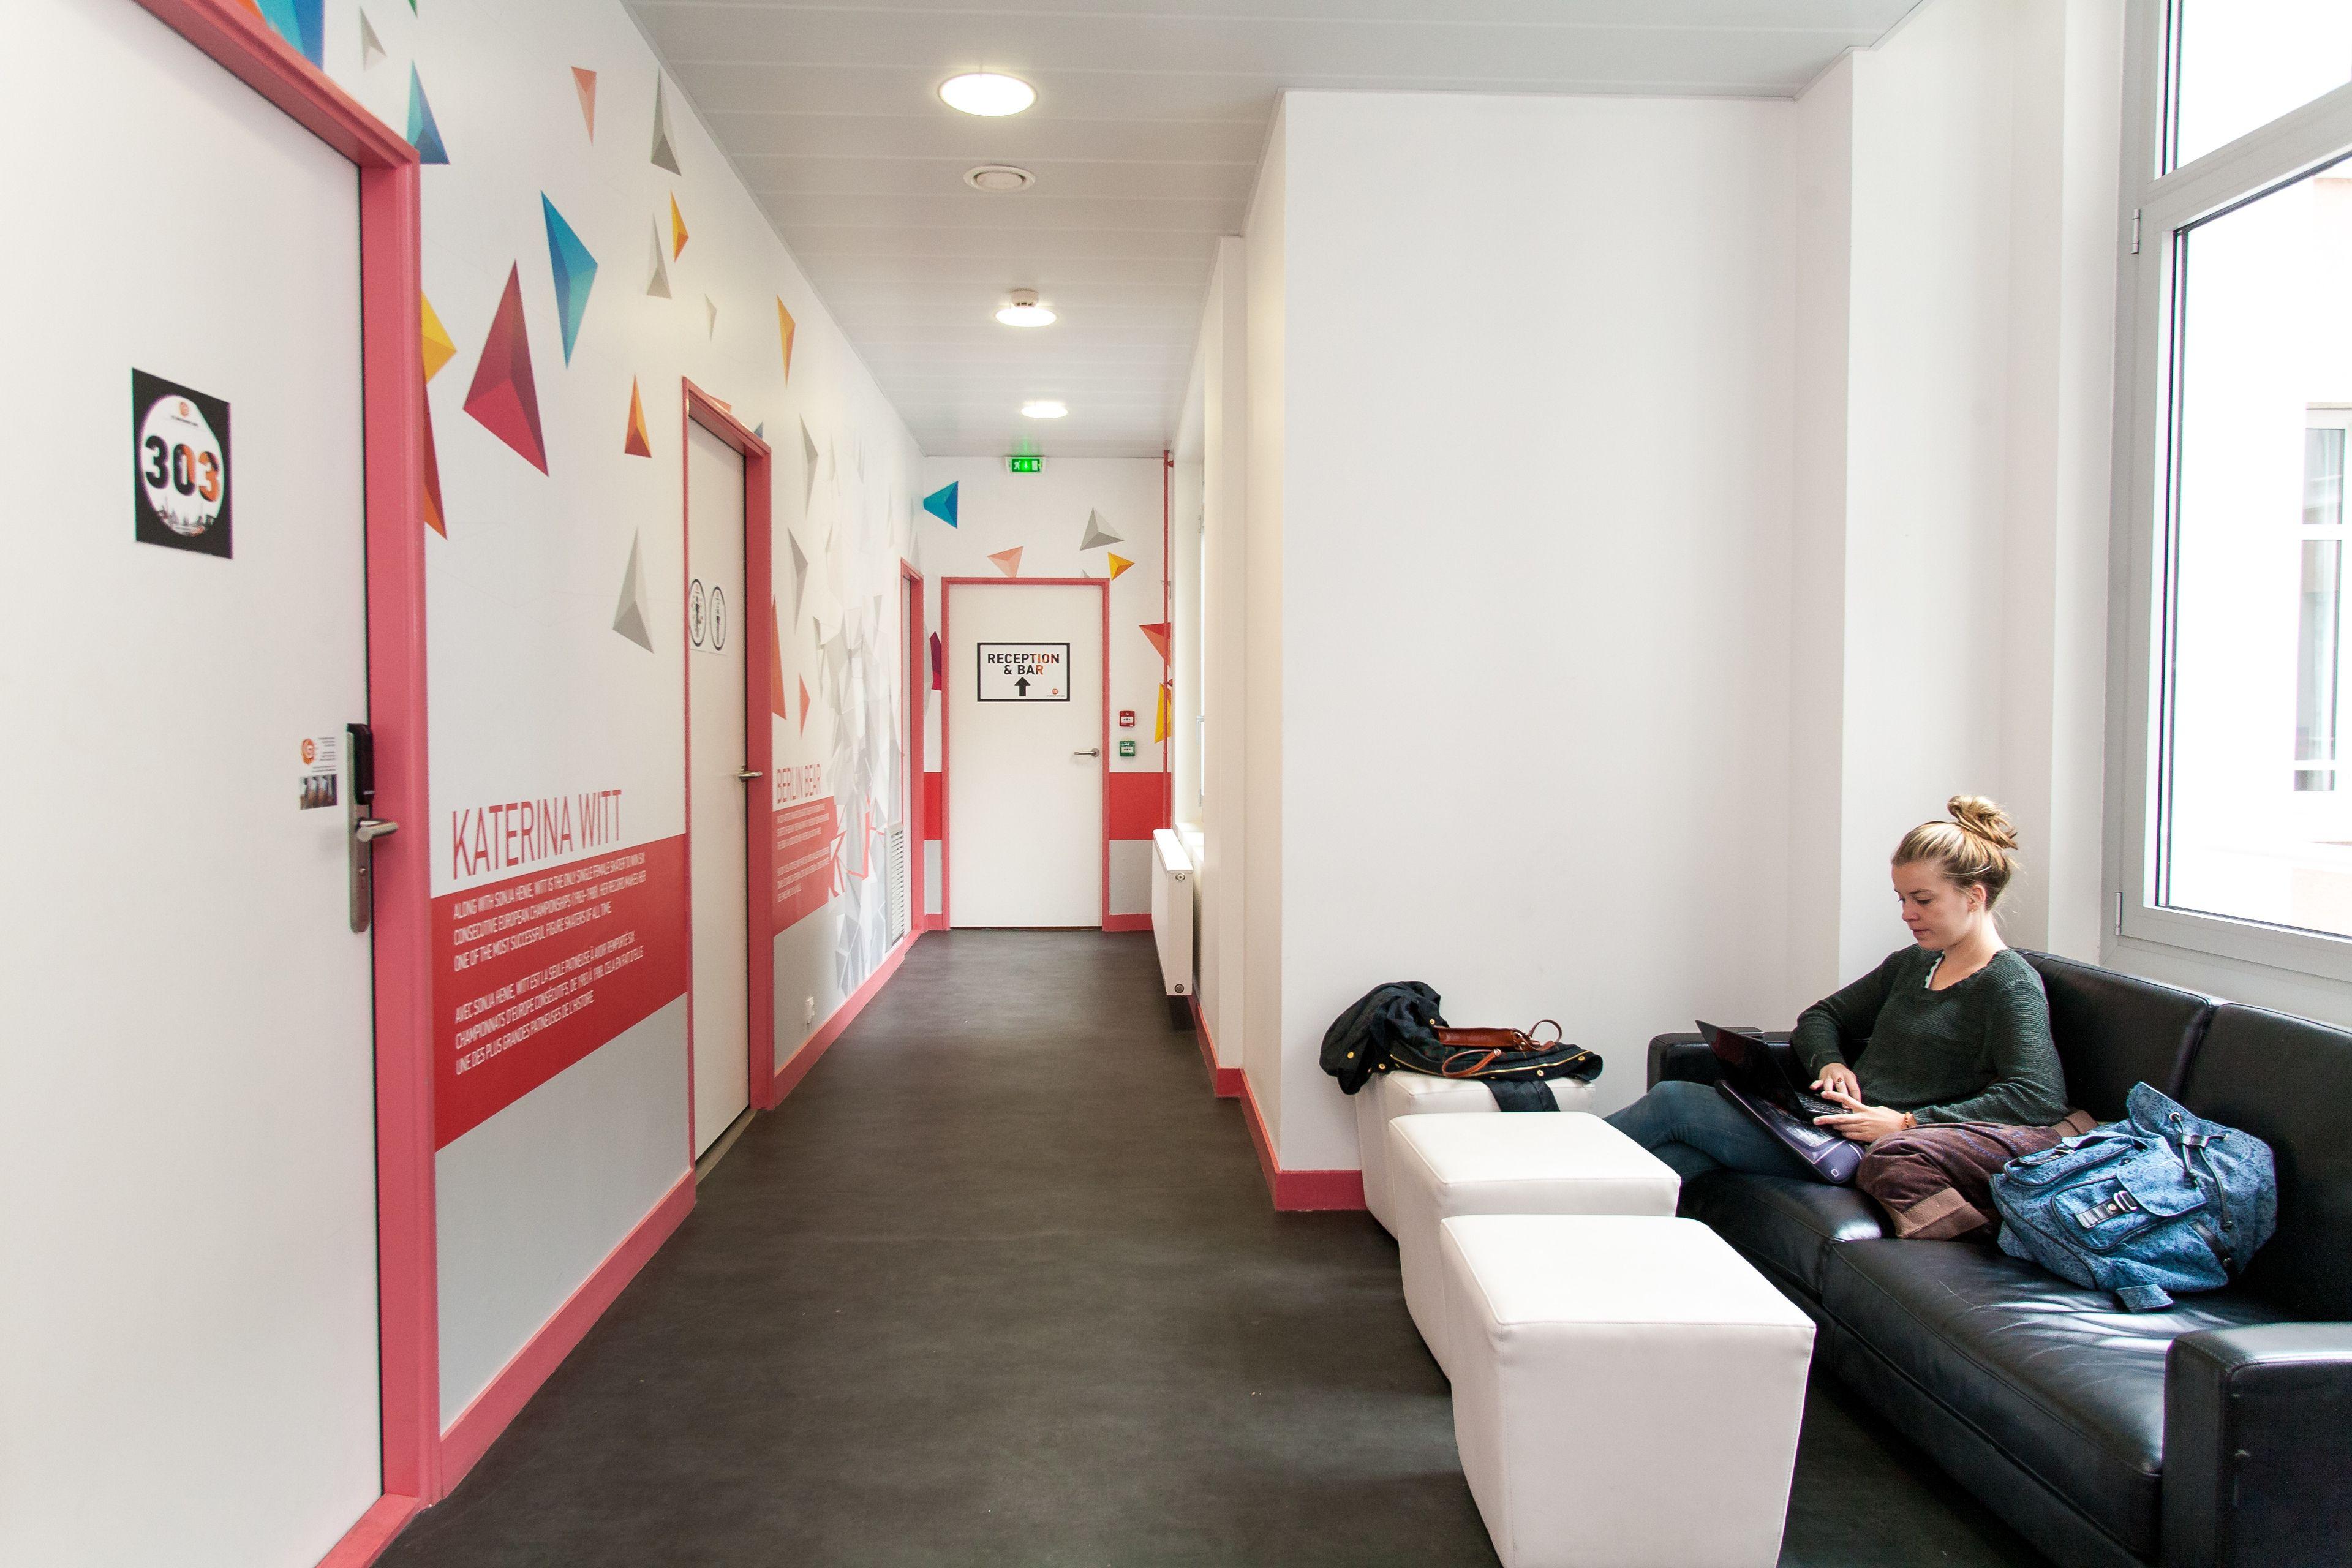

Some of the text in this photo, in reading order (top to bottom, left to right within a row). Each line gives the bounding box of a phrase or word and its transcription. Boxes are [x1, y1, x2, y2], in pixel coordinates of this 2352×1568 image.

[145, 435, 219, 502] 303
[988, 654, 1060, 664] RECEPTION
[1004, 665, 1044, 675] & BAR
[453, 789, 622, 880] KATERINA WITT
